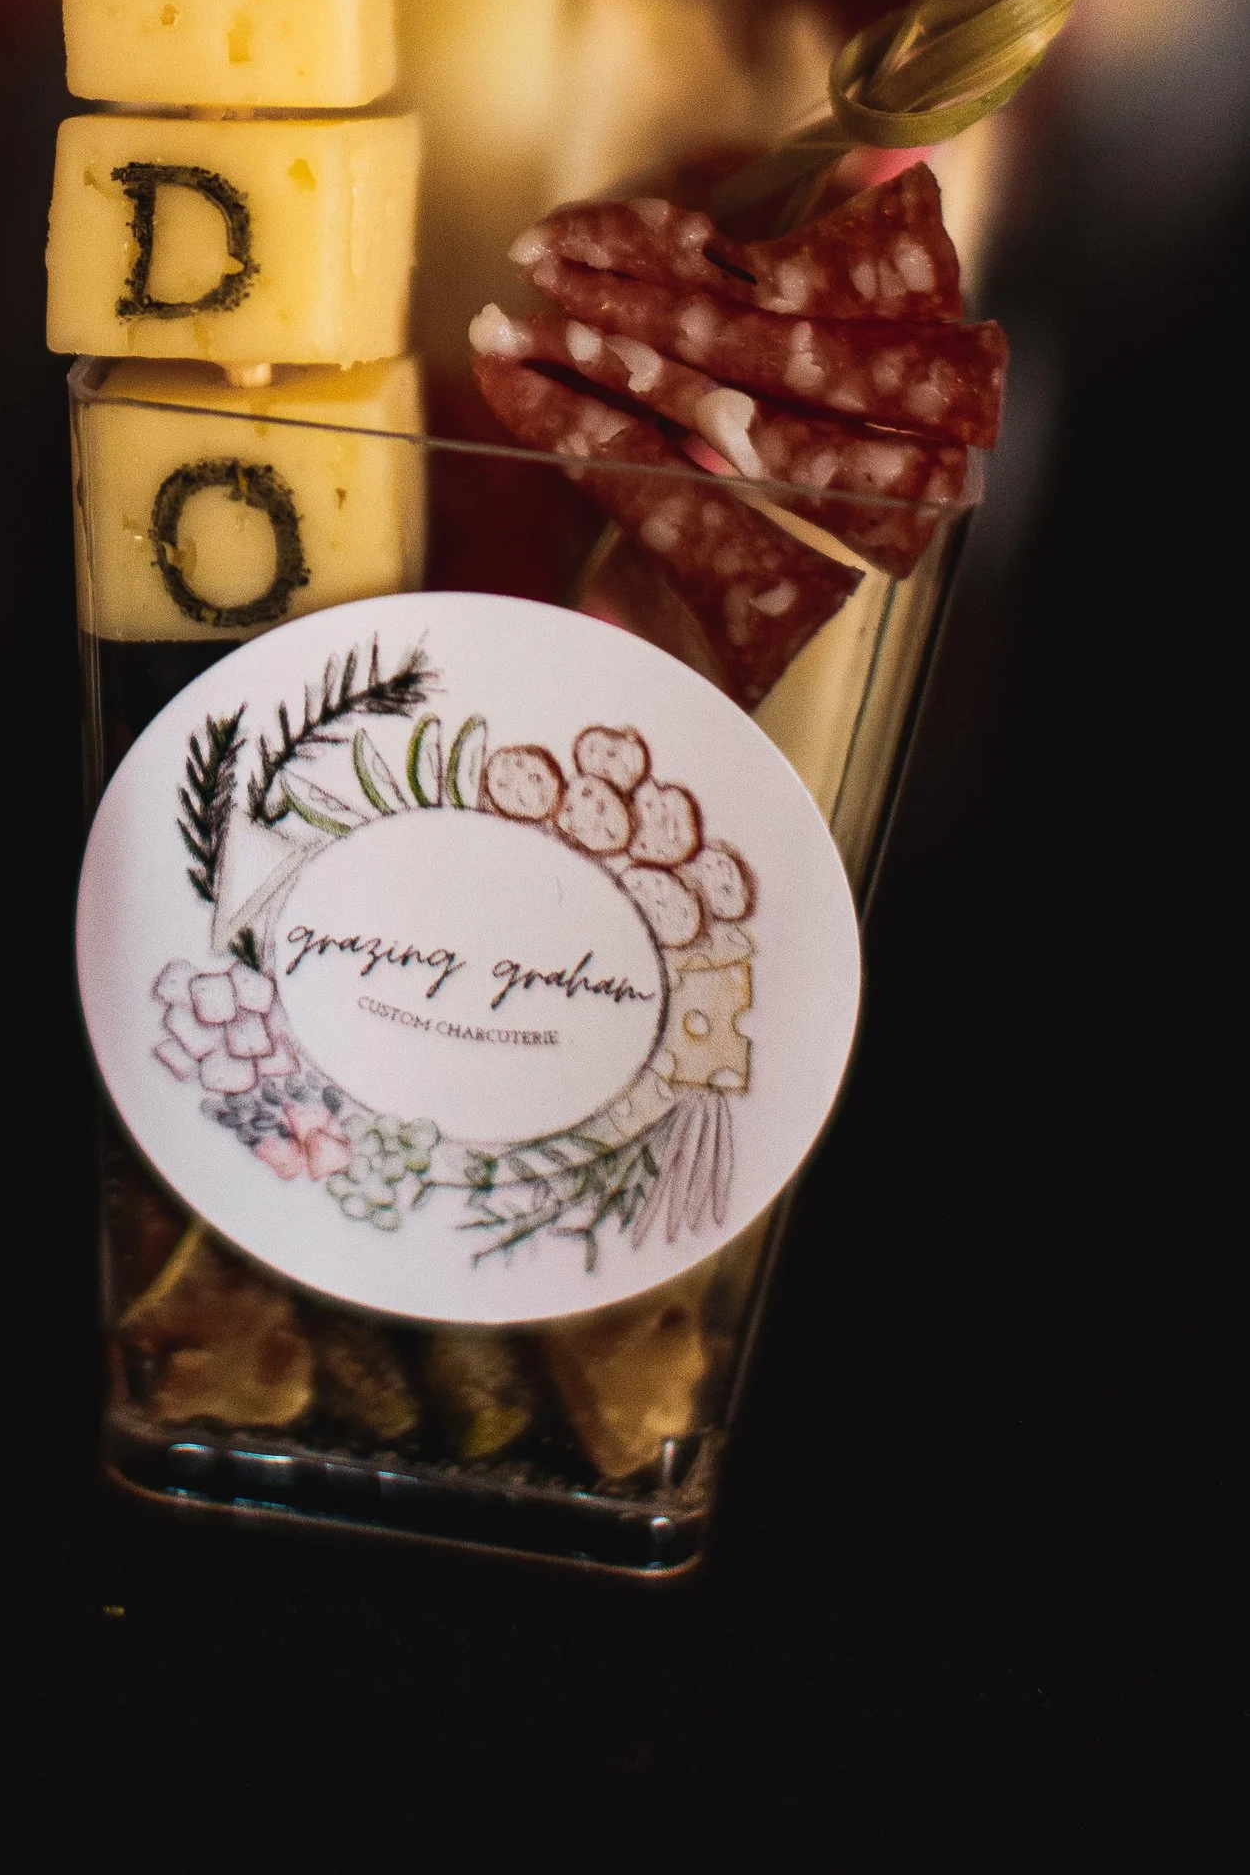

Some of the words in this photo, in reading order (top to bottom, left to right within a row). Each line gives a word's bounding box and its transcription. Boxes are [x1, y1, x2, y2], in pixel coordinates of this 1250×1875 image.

[286, 925, 466, 999] grazing
[491, 950, 656, 1010] graham
[357, 995, 432, 1032] CUSTOM
[435, 1019, 560, 1046] CHARCUTERIE
